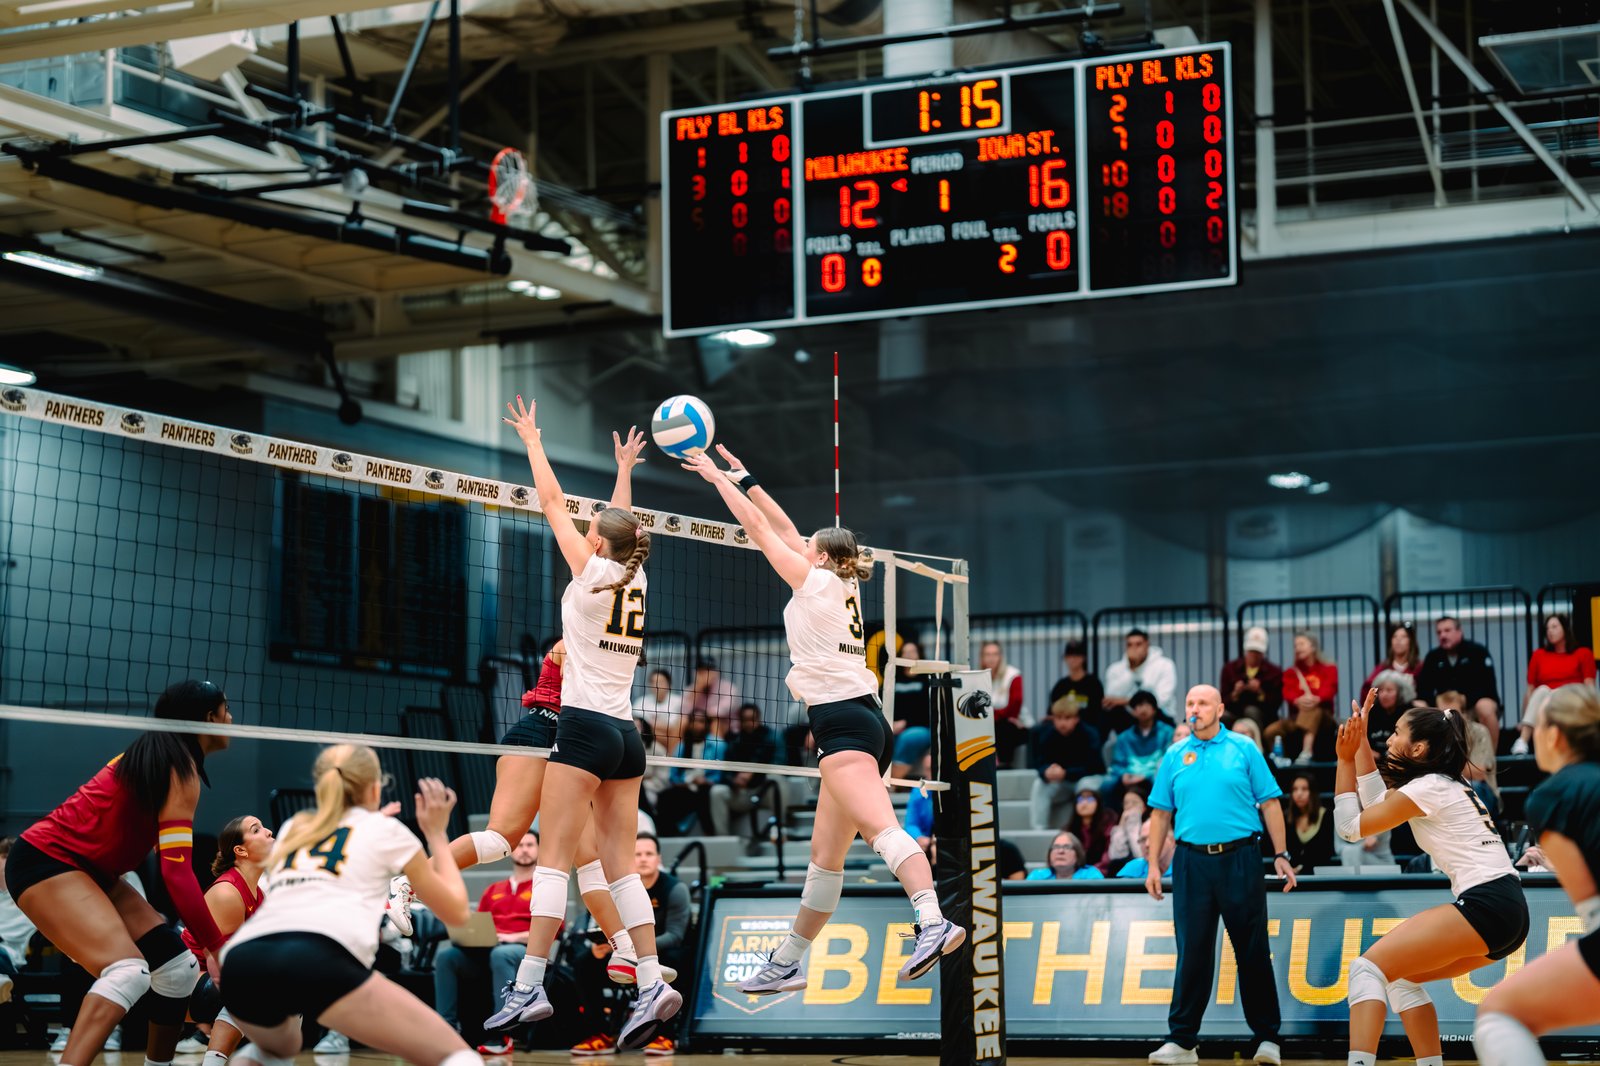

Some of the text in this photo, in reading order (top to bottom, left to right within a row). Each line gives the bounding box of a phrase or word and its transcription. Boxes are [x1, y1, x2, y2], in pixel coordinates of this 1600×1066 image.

[1096, 54, 1213, 90] PLY BL KLS
[919, 79, 1001, 133] 1:15
[1109, 83, 1221, 123] 2 1 0
[676, 115, 712, 141] PLY
[1112, 115, 1222, 151] 7 0 0
[739, 142, 748, 163] 1
[771, 134, 790, 162] 0
[911, 152, 964, 174] PERIOD
[805, 147, 909, 181] MILWAUKEE
[1102, 149, 1223, 188] 10 0 0
[730, 169, 748, 197] 0
[781, 167, 790, 189] 1
[939, 179, 950, 212] 1
[1028, 159, 1070, 209] 16
[731, 202, 748, 228] 0
[773, 197, 790, 224] 0
[840, 180, 880, 229] 12
[1158, 186, 1176, 215] 0
[1205, 181, 1223, 210] 2
[890, 219, 990, 246] PLAYER FOUL
[1027, 210, 1076, 233] FOULS
[806, 233, 852, 255] FOULS
[998, 243, 1018, 273] 2
[1046, 230, 1071, 270] 0
[821, 253, 846, 292] 0
[862, 257, 882, 287] 0
[44, 399, 105, 426] PANTHERS
[160, 422, 216, 447] PANTHERS
[267, 442, 318, 466] PANTHERS
[366, 461, 412, 484] PANTHERS
[456, 478, 499, 499] PANTHERS
[690, 522, 725, 541] PANTHERS
[604, 587, 644, 640] 12
[845, 596, 864, 640] 3
[539, 708, 558, 722] NIK
[969, 780, 1002, 1062] MILWAUKEE
[729, 935, 787, 953] ARM
[724, 965, 762, 982] GUA
[803, 922, 935, 1005] BE
